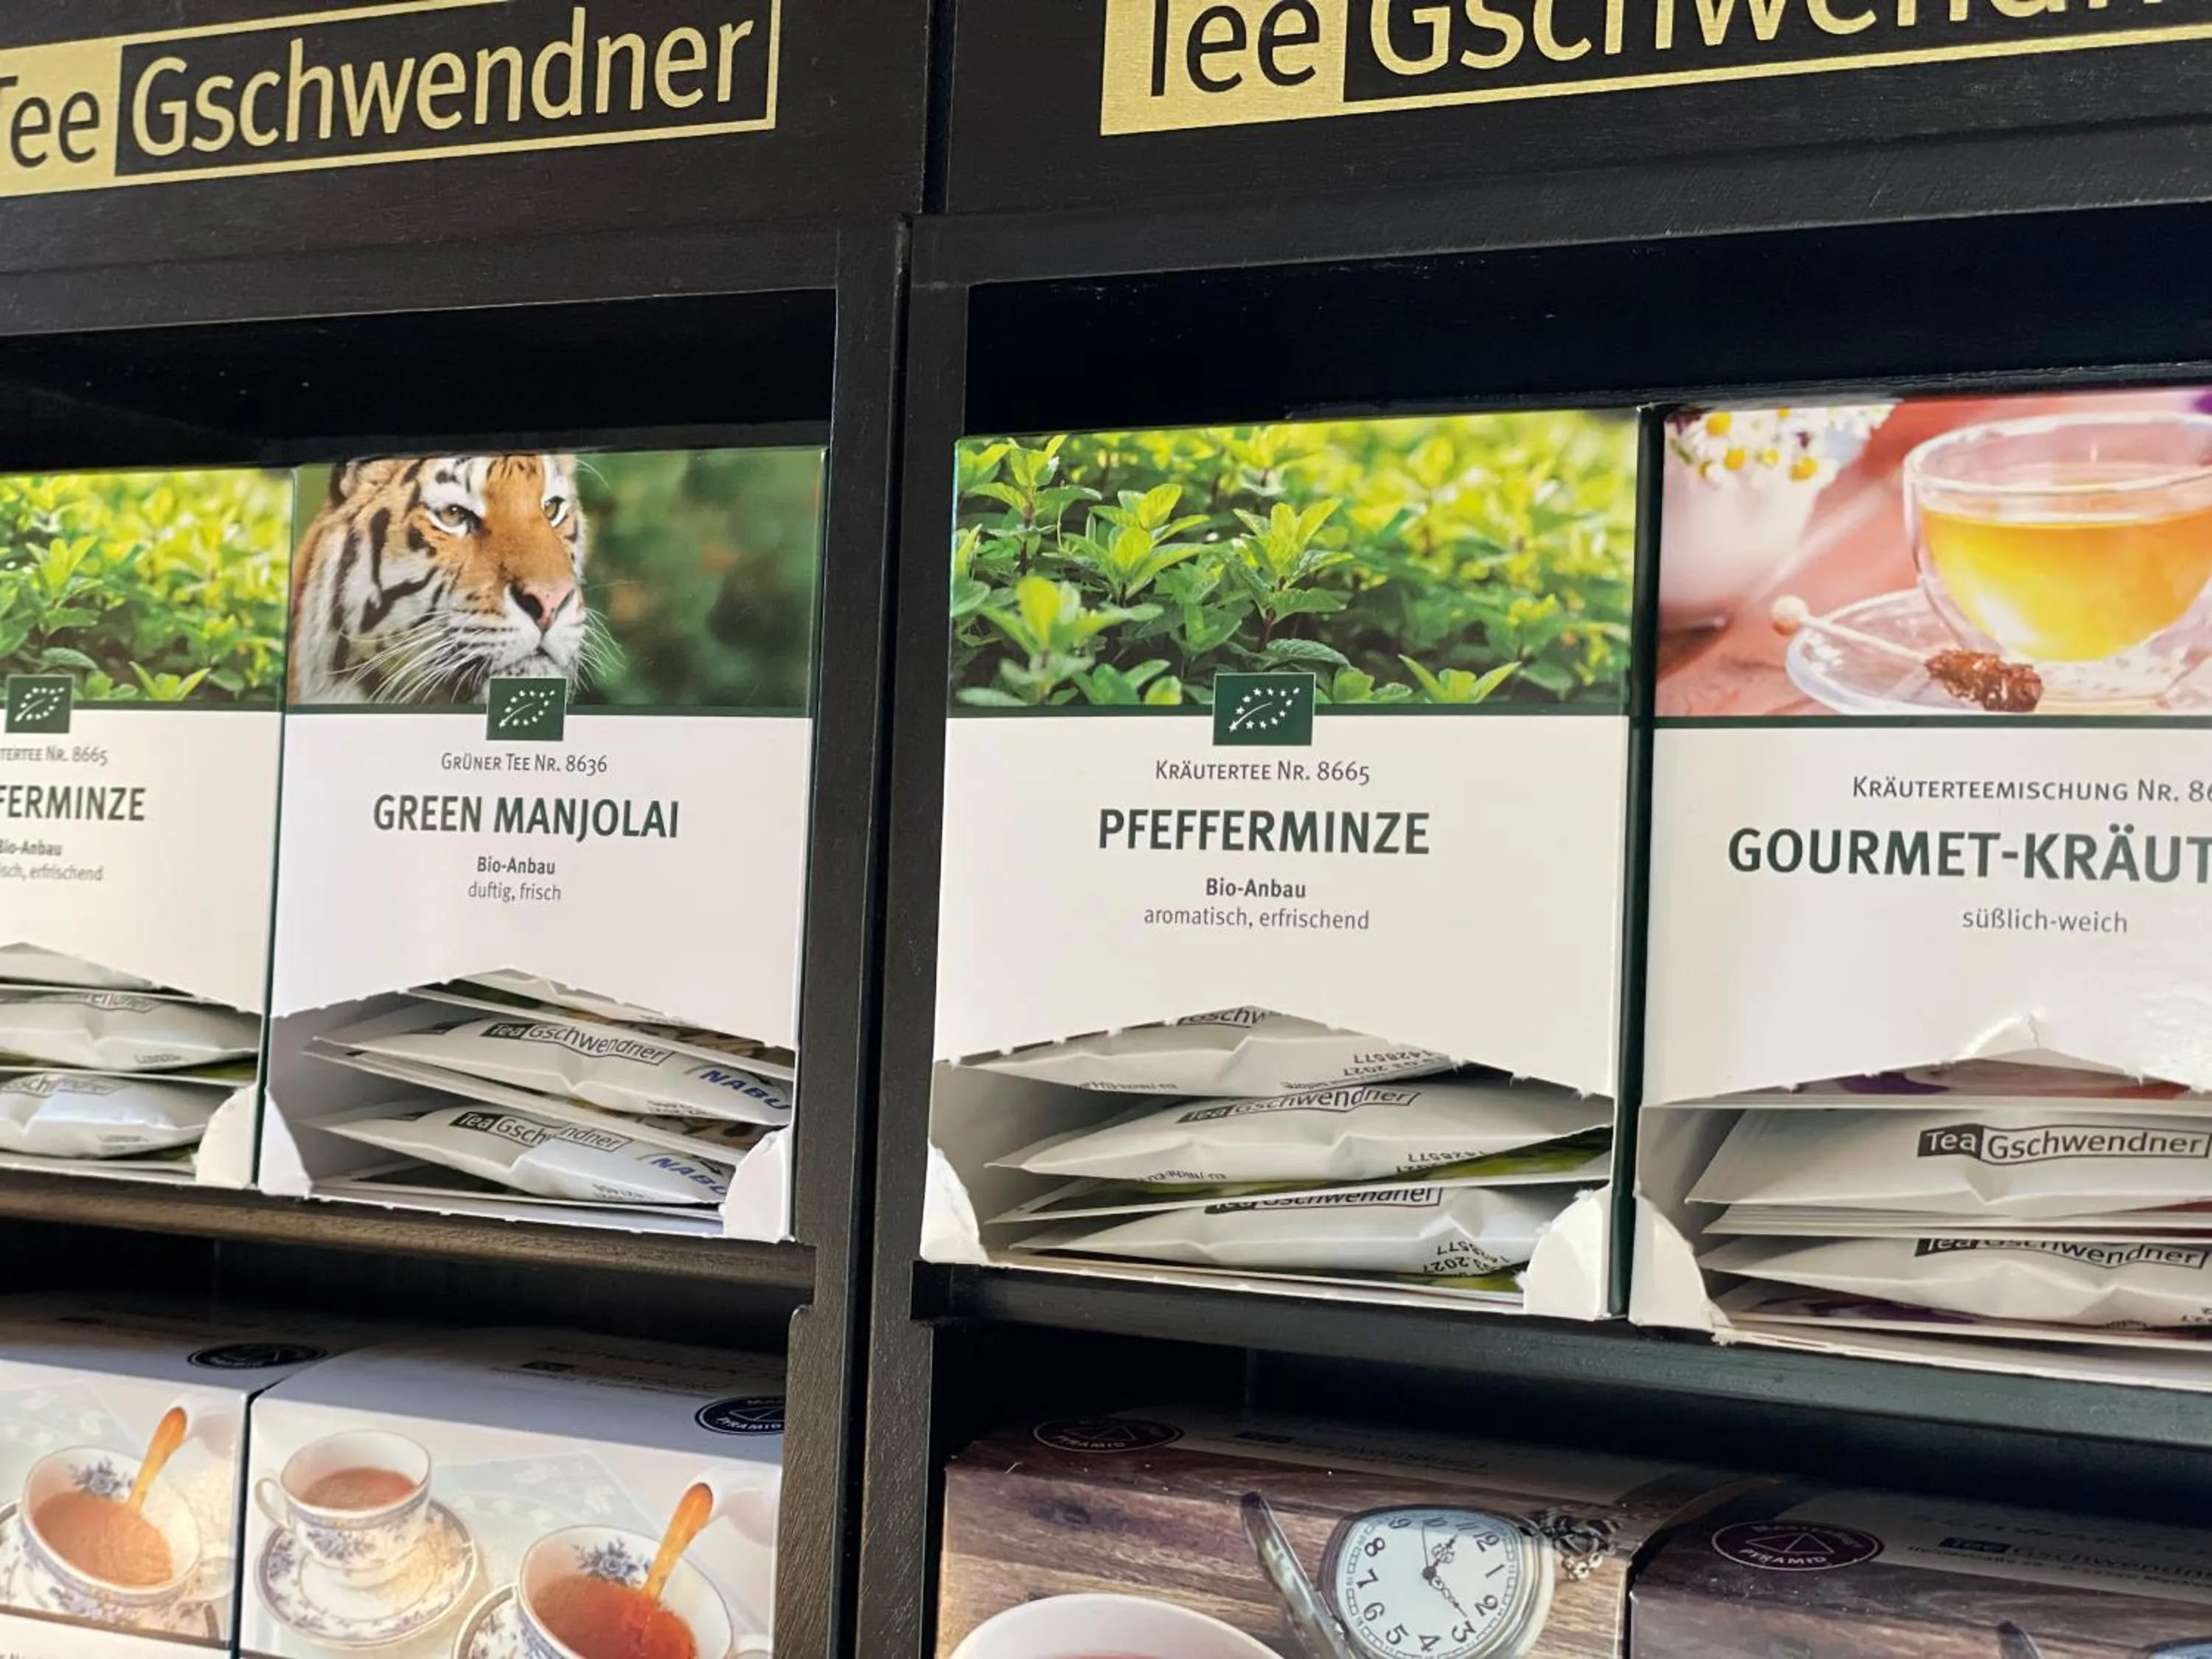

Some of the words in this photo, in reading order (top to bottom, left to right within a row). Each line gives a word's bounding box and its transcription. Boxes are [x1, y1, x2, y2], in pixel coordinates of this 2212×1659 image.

[0, 75, 100, 168] ee
[132, 7, 754, 156] Gschwendner
[72, 746, 108, 767] 8665
[566, 754, 608, 776] 8636
[1317, 762, 1371, 786] 8665
[373, 794, 483, 832] GREEN
[493, 796, 679, 843] MANJOLAI
[1099, 808, 1430, 855] PFEFFERMINZE
[1728, 822, 2212, 884] GOURMET-KRÄUT
[476, 856, 556, 875] Bio-Anbau
[468, 881, 515, 902] duftig,
[520, 882, 562, 901] frisch
[1205, 877, 1307, 898] Bio-Anbau
[1144, 906, 1253, 929] aromatisch,
[1259, 908, 1370, 930] erfrischend
[1962, 907, 2129, 934] süßlich-weich
[528, 1023, 664, 1060] Gschwendner
[700, 1070, 791, 1110] NABU
[459, 1113, 492, 1130] Tea
[496, 1118, 621, 1148] Gschndner
[1926, 1130, 1977, 1152] Tea
[1987, 1130, 2203, 1160] Gschwendner
[1363, 1537, 1385, 1557] 8
[1473, 1531, 1500, 1553] 12
[1356, 1568, 1379, 1589] 7
[1363, 1601, 1385, 1621] 6
[1474, 1594, 1498, 1617] 2
[1385, 1624, 1409, 1646] 5
[1418, 1634, 1441, 1653] 4
[1451, 1620, 1476, 1644] 3
